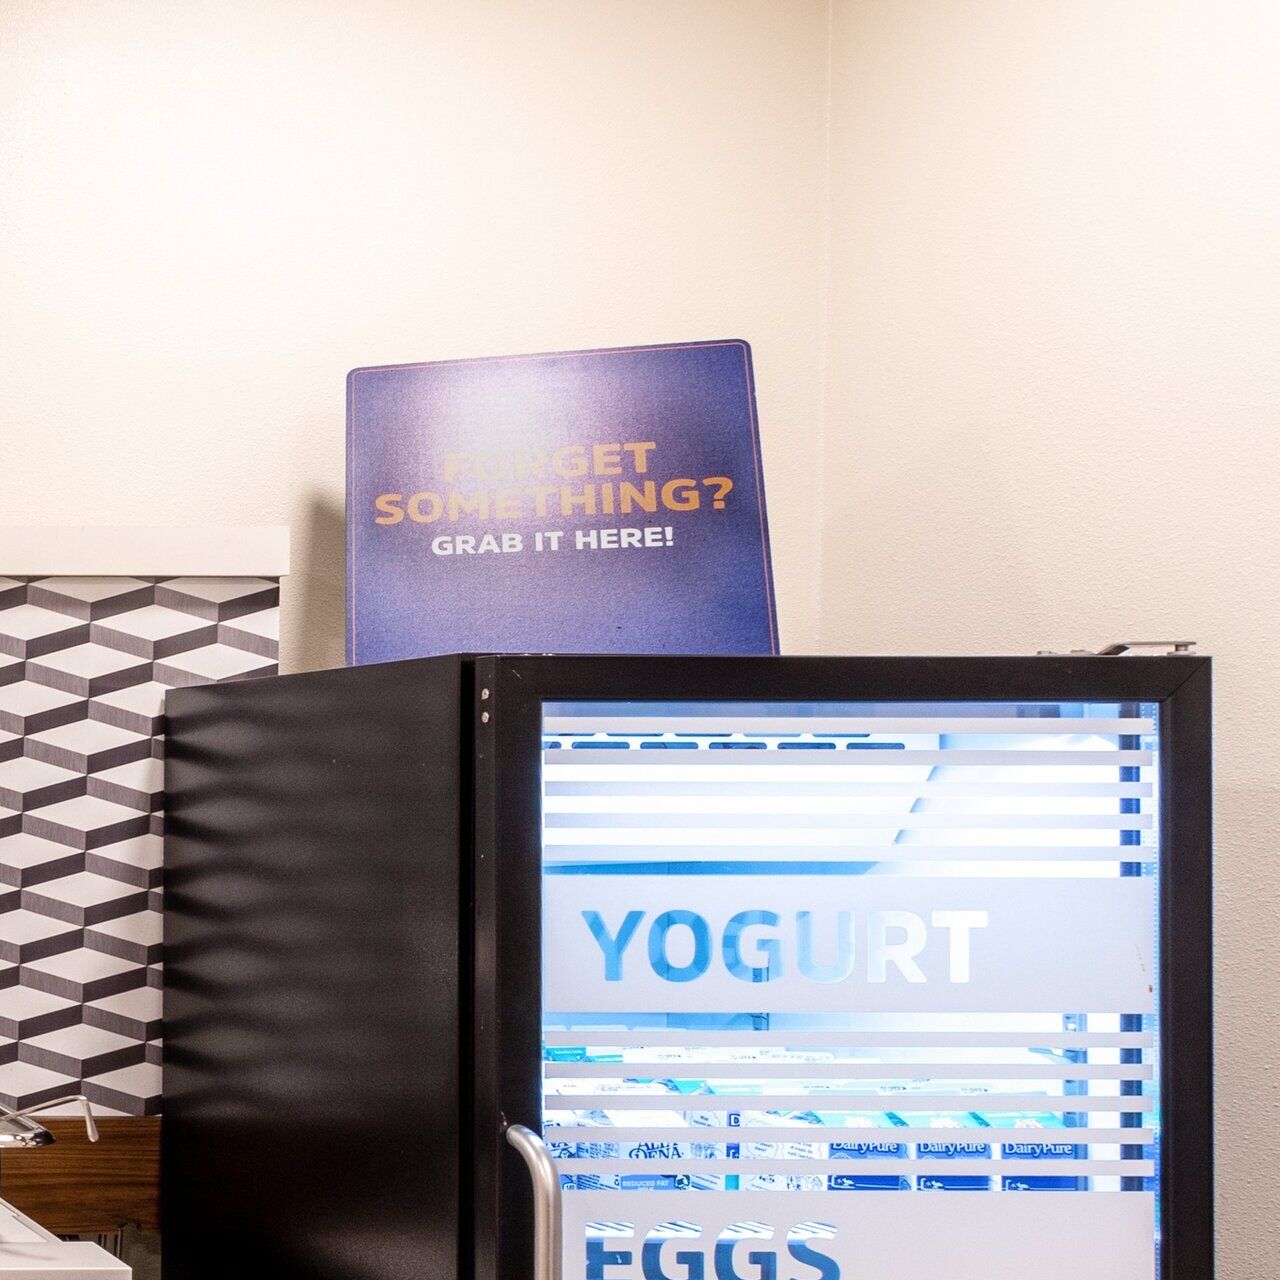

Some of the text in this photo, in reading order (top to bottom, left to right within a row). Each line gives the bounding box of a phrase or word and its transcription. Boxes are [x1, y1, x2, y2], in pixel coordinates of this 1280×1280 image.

[443, 441, 657, 484] FORGET
[375, 477, 734, 525] SOMETHING?
[431, 526, 674, 556] GRAB IT HERE!
[581, 909, 989, 984] YOGURT
[1005, 1143, 1073, 1155] DairyPure
